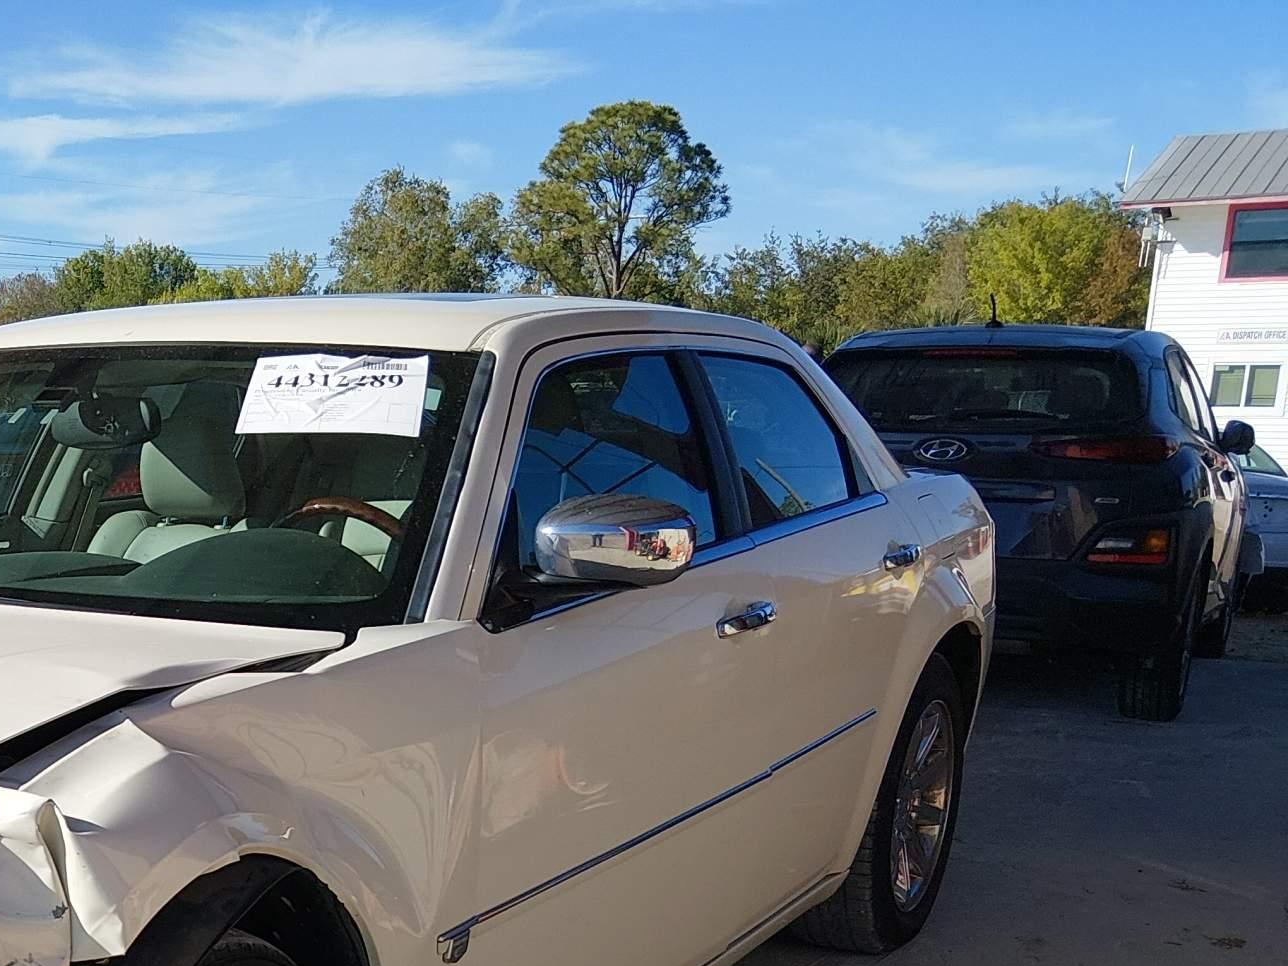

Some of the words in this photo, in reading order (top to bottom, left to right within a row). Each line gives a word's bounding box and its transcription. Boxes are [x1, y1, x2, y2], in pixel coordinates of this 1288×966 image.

[1232, 331, 1263, 340] DISPATCH
[1264, 330, 1287, 340] OFFICE
[267, 373, 404, 388] 44312289
